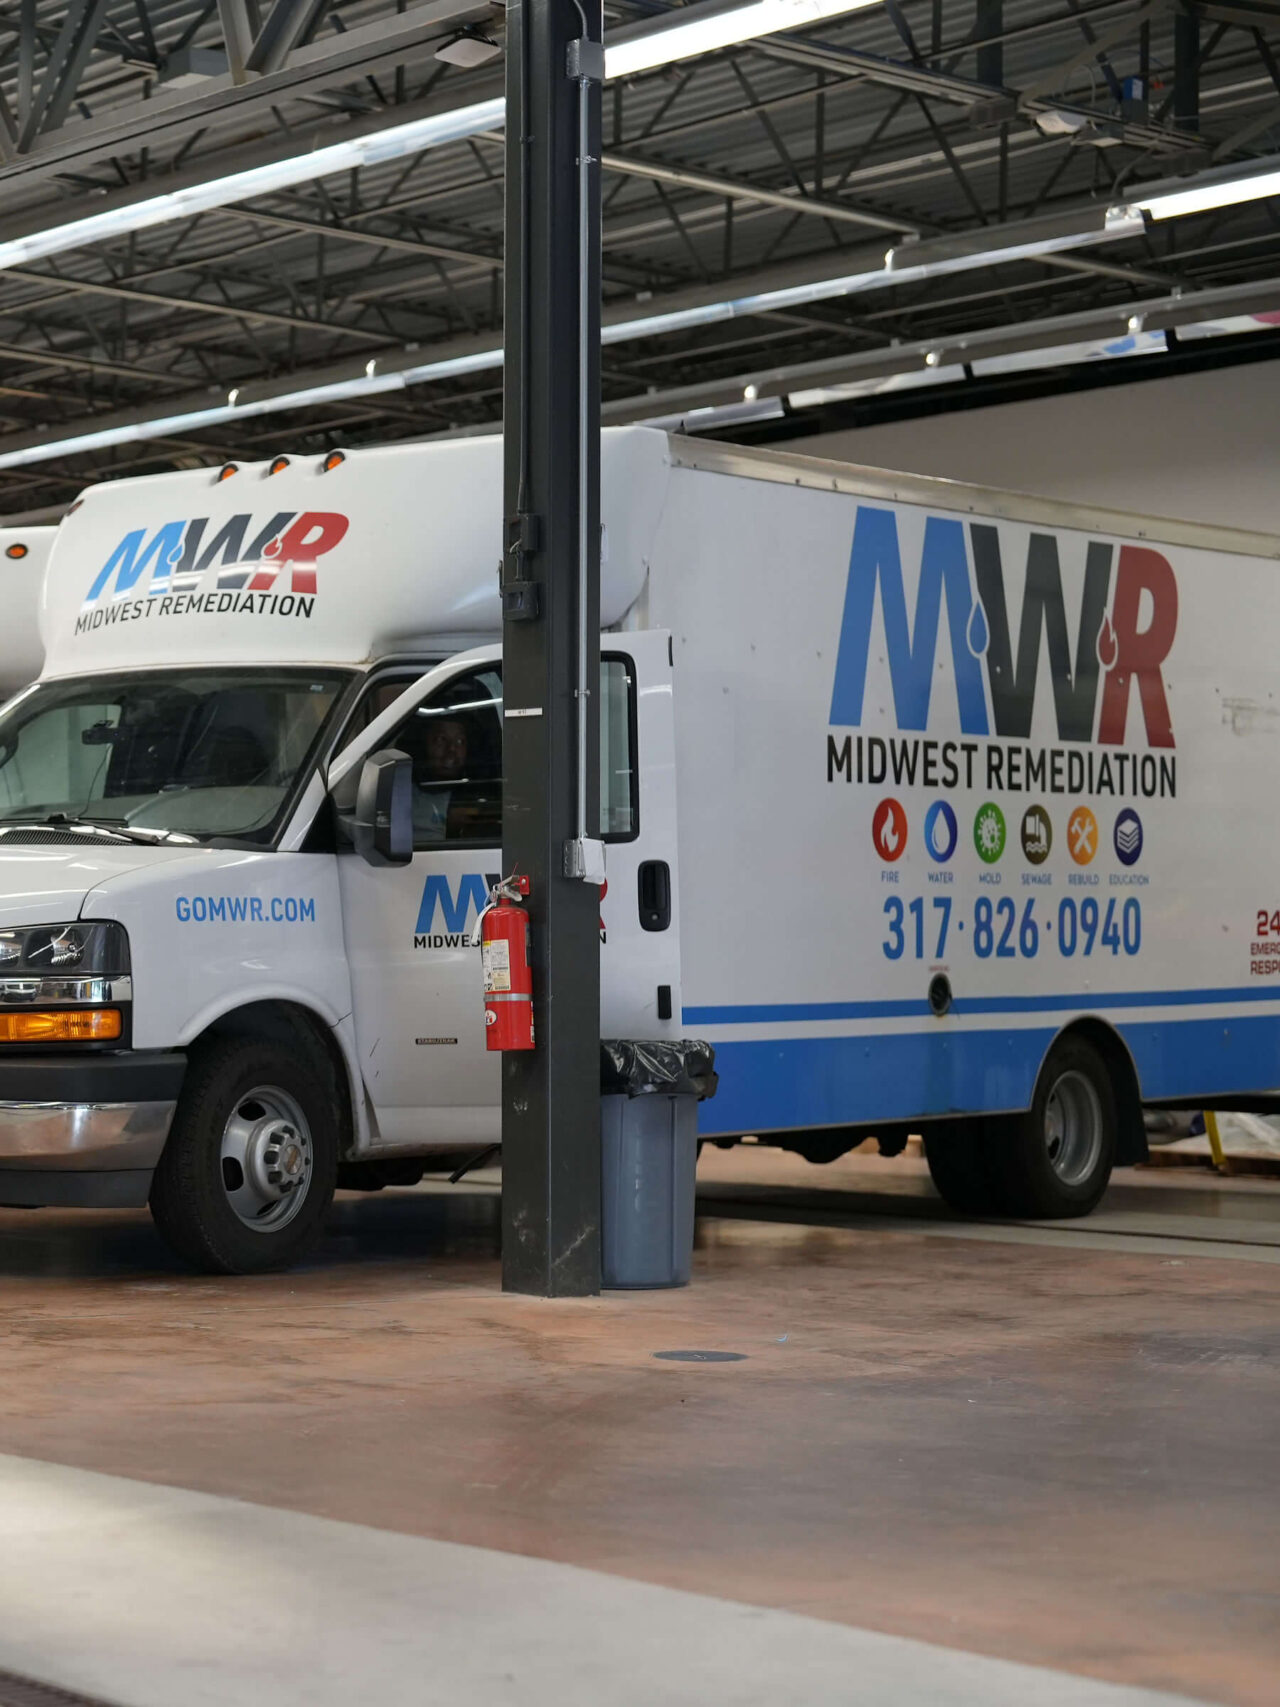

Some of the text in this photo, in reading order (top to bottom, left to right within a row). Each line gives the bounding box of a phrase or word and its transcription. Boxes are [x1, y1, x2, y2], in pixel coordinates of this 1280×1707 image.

[79, 512, 349, 611] MWR
[74, 592, 315, 636] MIDWEST REMEDIATION
[829, 505, 1178, 749] MWR
[827, 735, 1176, 798] MIDWEST REMEDIATION
[881, 871, 900, 884] FIRE
[928, 871, 954, 884] WATER
[979, 872, 1003, 885] MOLD
[1021, 873, 1053, 886] SEWAGE
[1068, 873, 1100, 886] REBUILD
[1109, 874, 1150, 886] EDUCATION
[176, 897, 316, 922] GOMWR.COM
